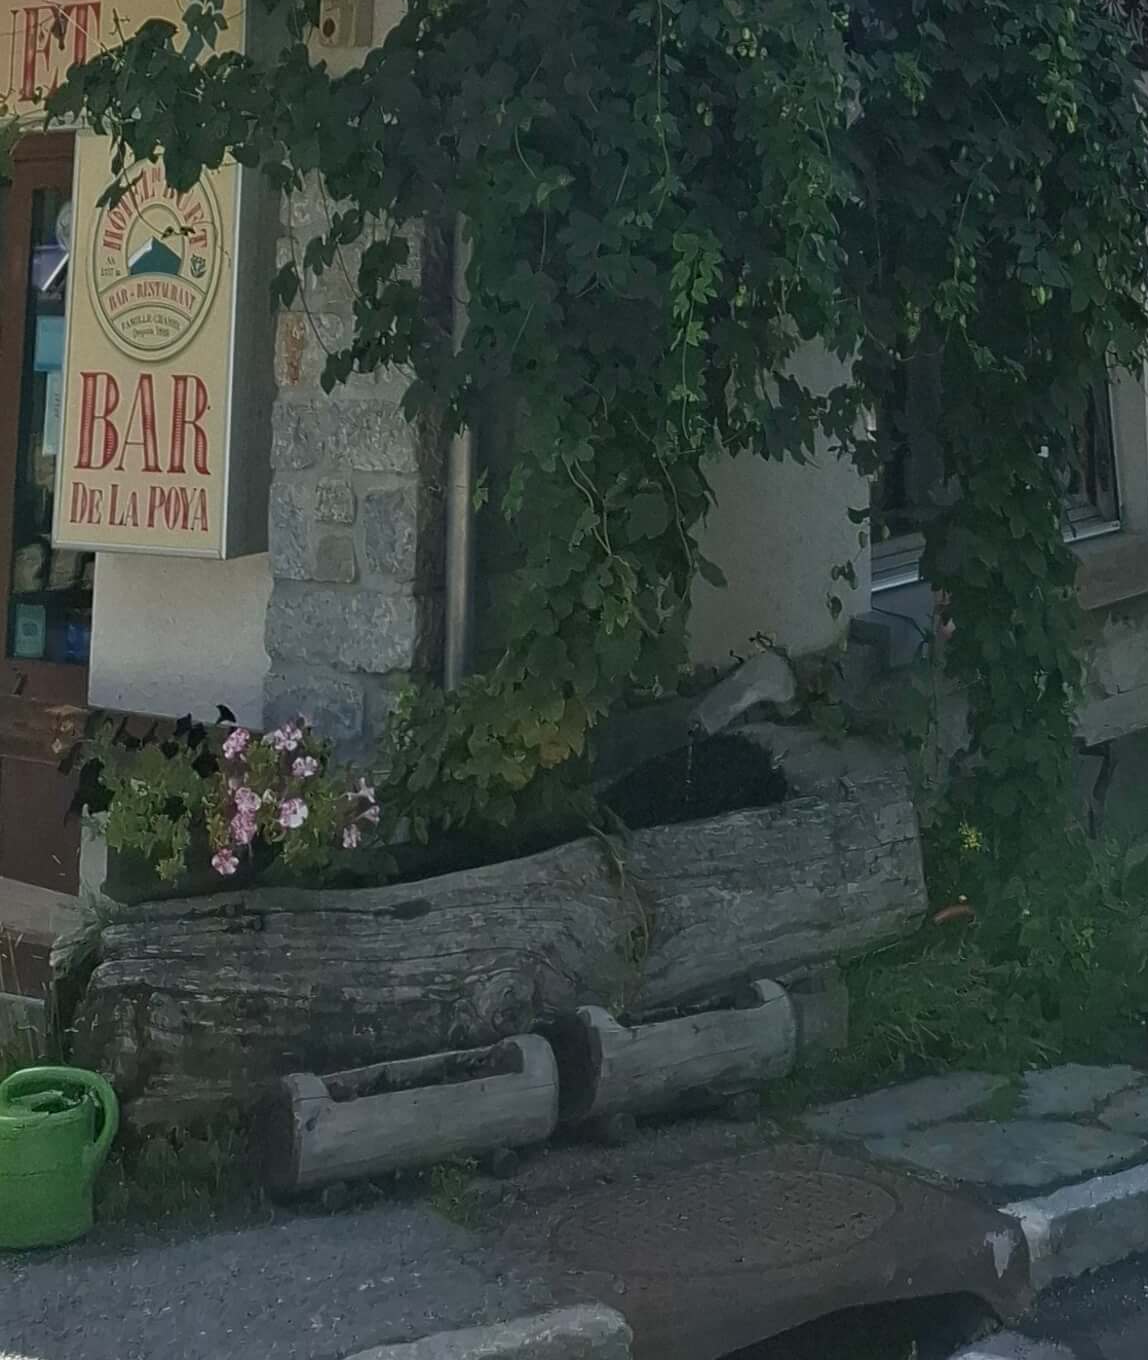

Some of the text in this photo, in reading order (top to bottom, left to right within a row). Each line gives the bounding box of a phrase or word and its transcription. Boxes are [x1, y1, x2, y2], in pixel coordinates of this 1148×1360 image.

[10, 0, 102, 104] ET
[108, 288, 129, 312] BAR
[73, 371, 211, 475] BAR
[69, 481, 209, 532] DE LA POYA
